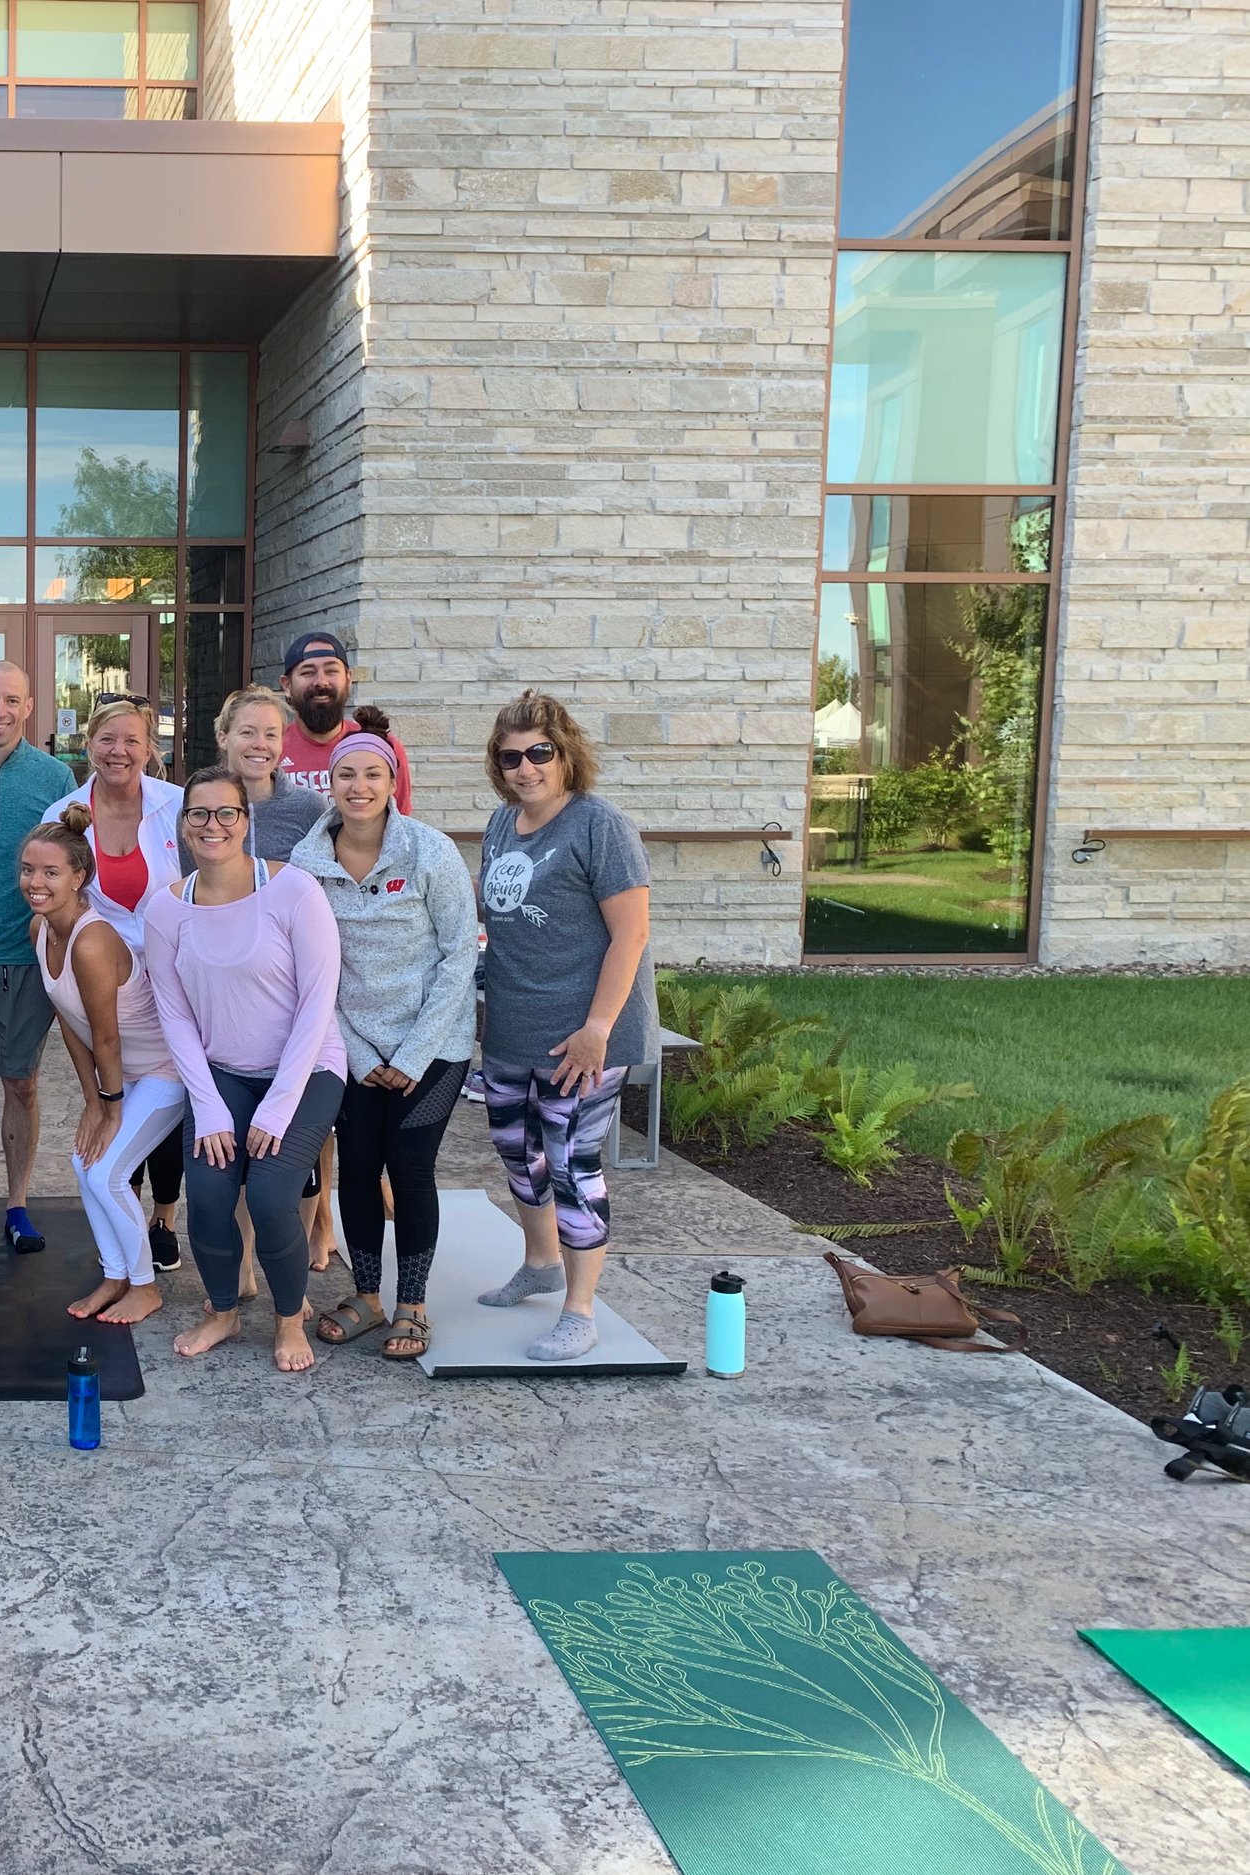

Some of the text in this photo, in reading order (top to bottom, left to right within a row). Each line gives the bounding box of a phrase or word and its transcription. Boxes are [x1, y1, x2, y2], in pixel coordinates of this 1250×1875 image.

[285, 770, 331, 790] ISCO
[491, 857, 525, 882] Keep
[385, 878, 407, 895] W
[487, 880, 522, 903] going
